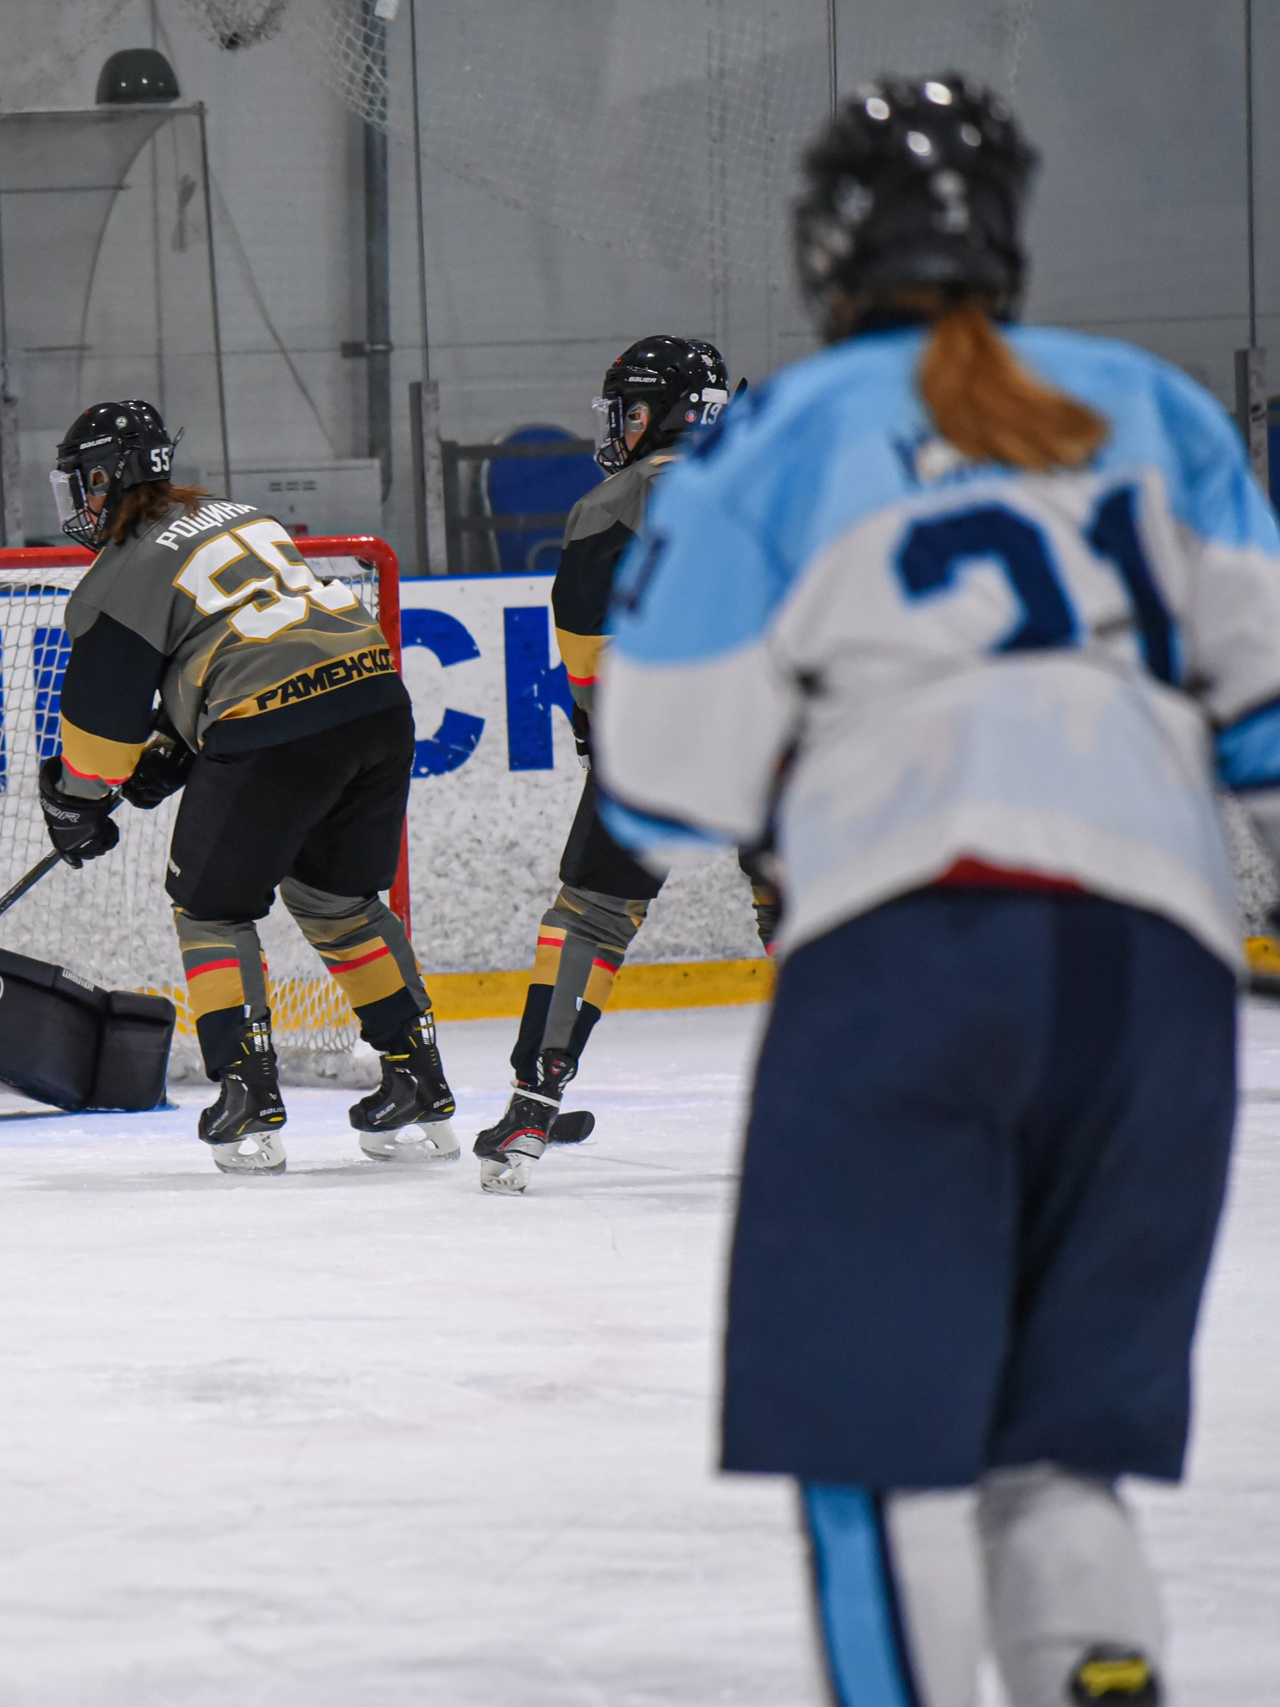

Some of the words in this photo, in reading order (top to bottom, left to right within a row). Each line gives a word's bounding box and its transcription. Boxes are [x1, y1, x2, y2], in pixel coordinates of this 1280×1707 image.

[700, 402, 723, 425] 19
[151, 447, 170, 473] 55
[155, 501, 258, 551] РОЩИНА
[172, 518, 358, 642] 55
[254, 648, 394, 711] РАМЕНСКО
